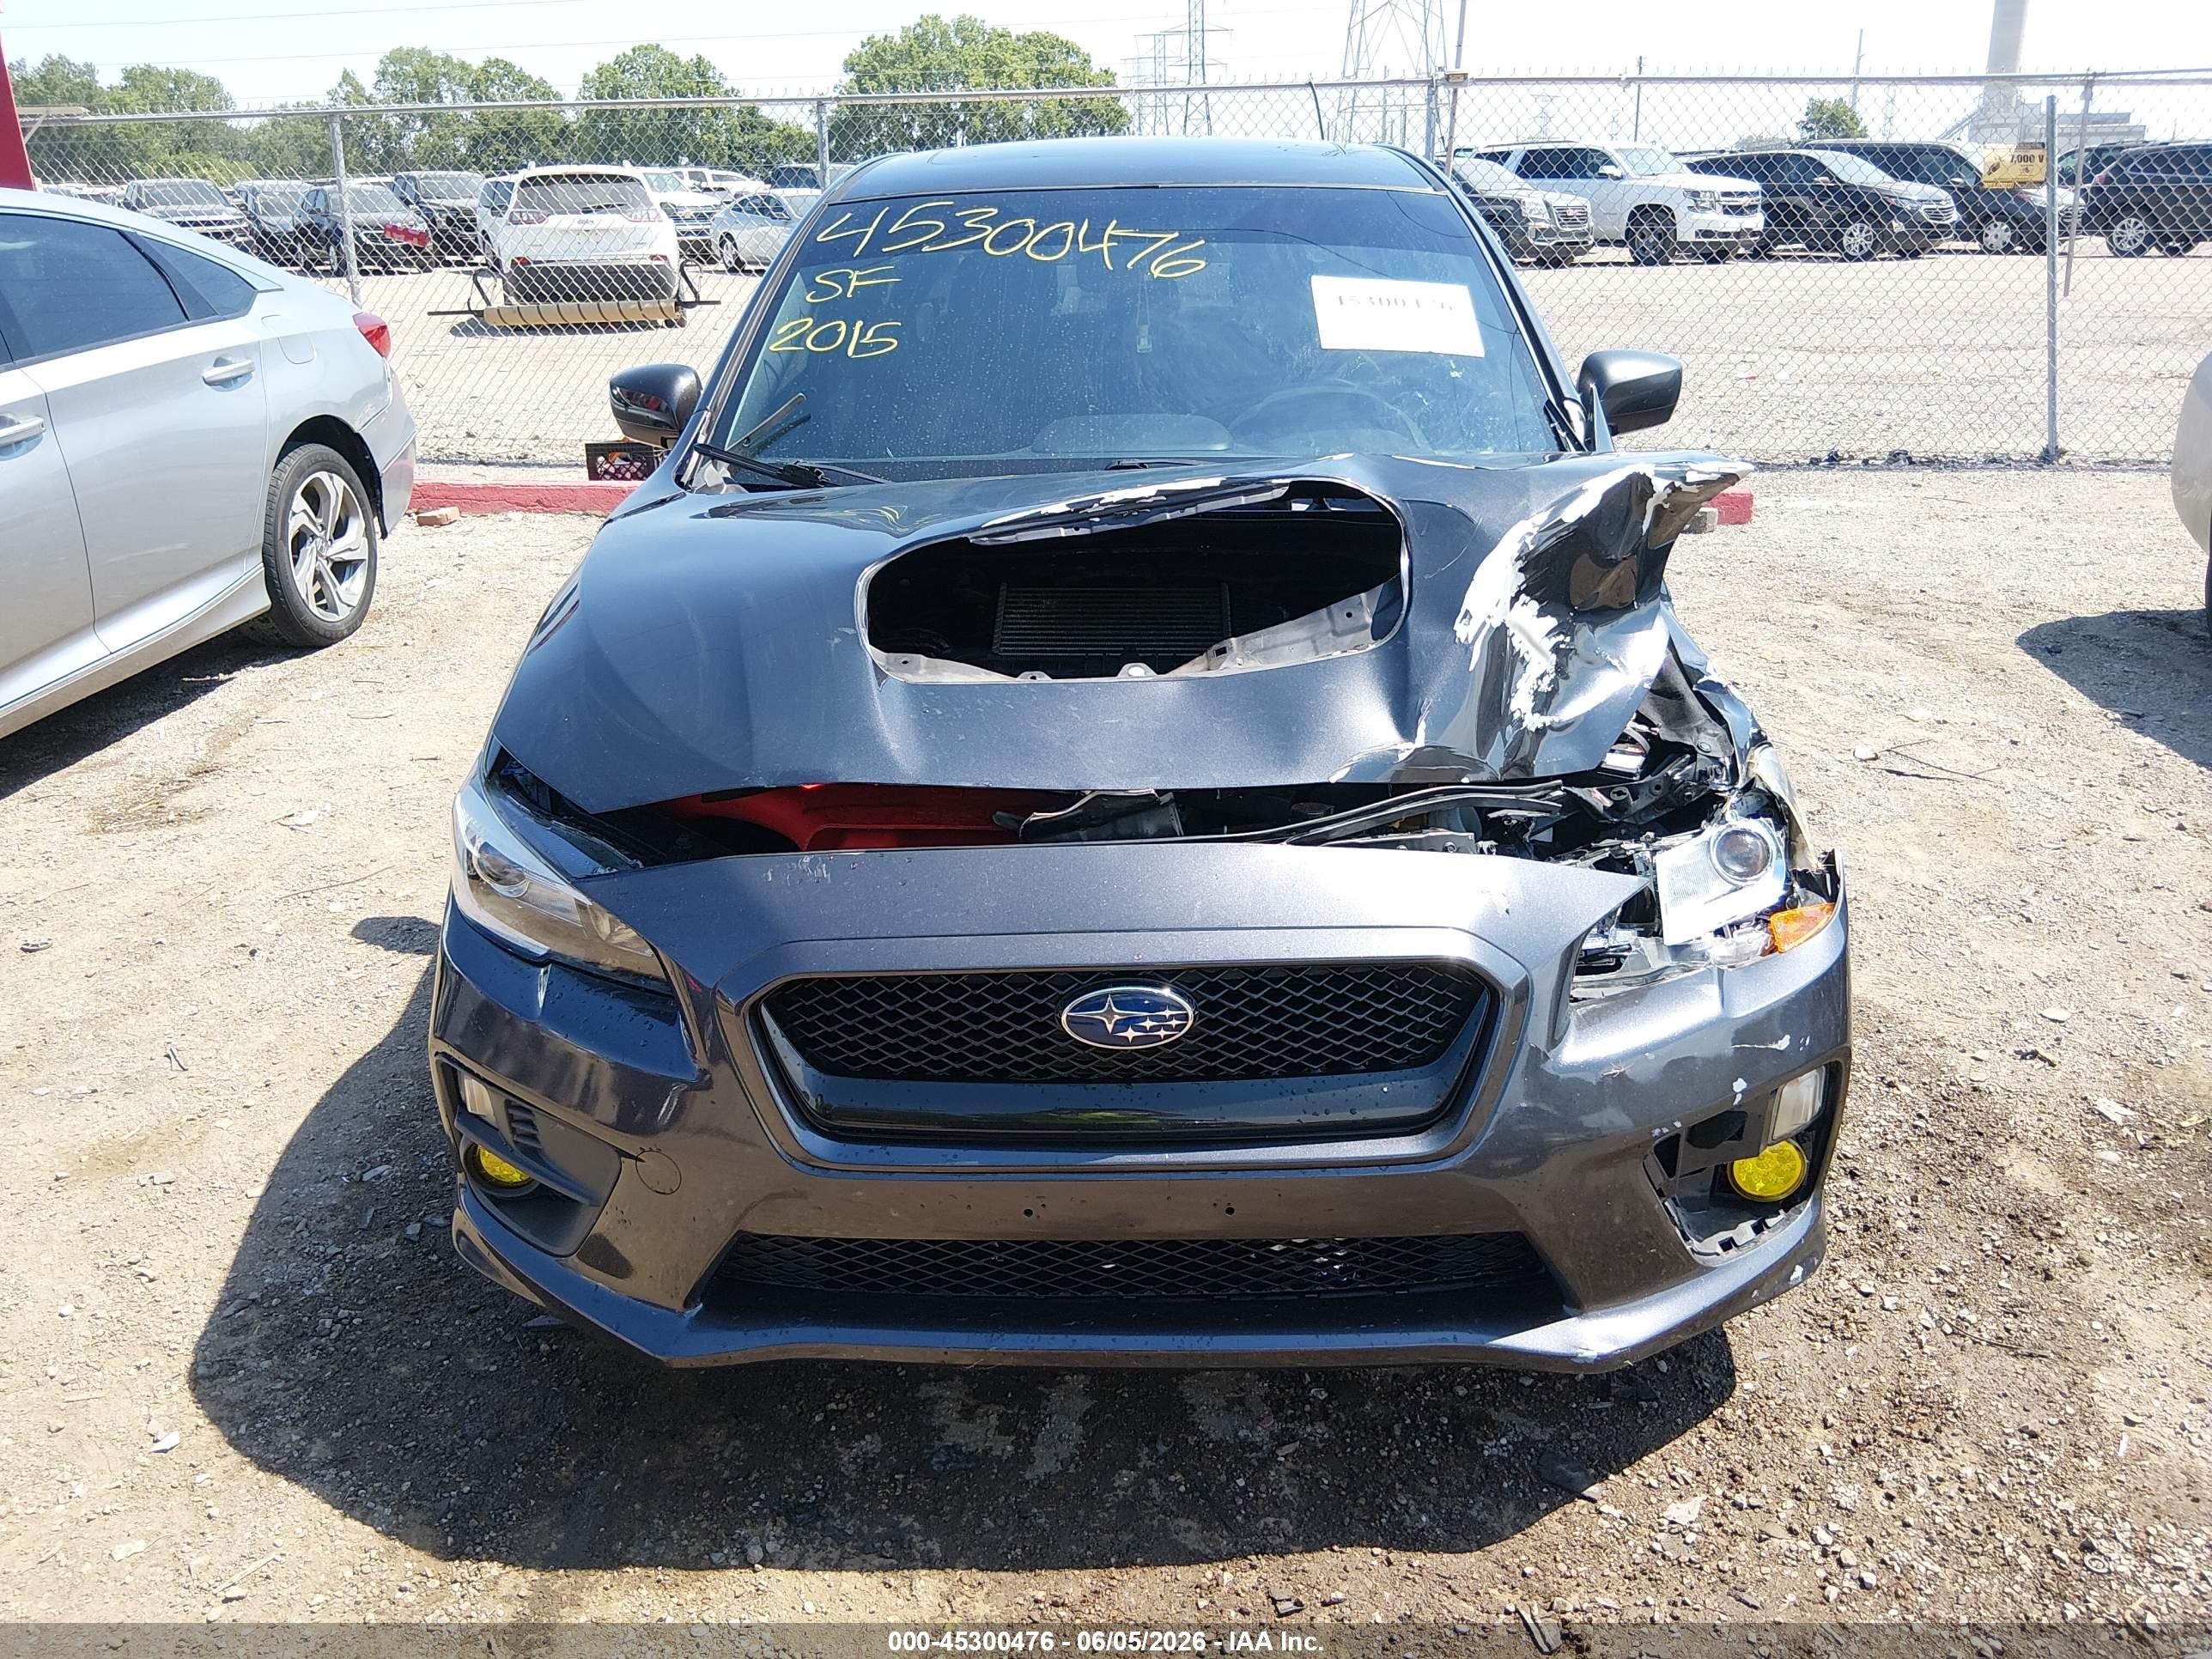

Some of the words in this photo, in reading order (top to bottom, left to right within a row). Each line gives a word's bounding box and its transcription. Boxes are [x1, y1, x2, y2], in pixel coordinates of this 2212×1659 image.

[815, 200, 1209, 280] 45300476
[805, 265, 903, 305] SF
[769, 316, 902, 359] 2015
